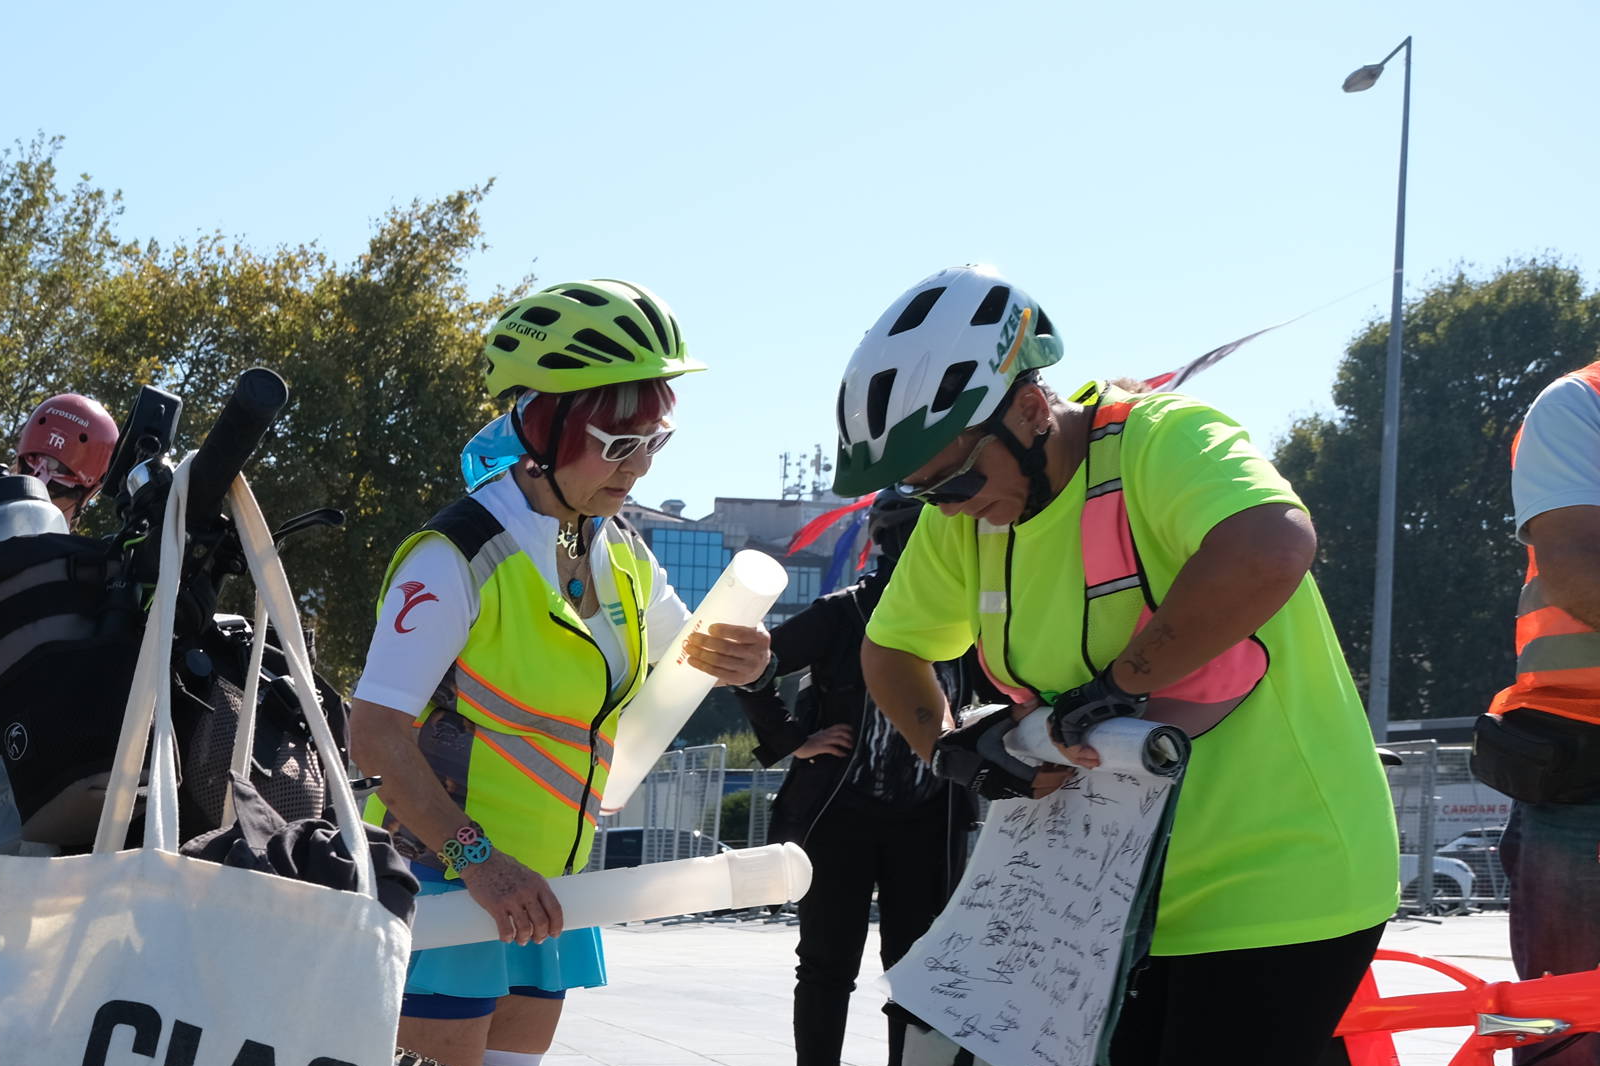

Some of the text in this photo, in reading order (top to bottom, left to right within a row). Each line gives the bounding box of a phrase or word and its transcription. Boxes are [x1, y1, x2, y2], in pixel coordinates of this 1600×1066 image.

[515, 324, 548, 342] GIRO
[988, 304, 1024, 374] LAZER
[48, 432, 66, 450] TR
